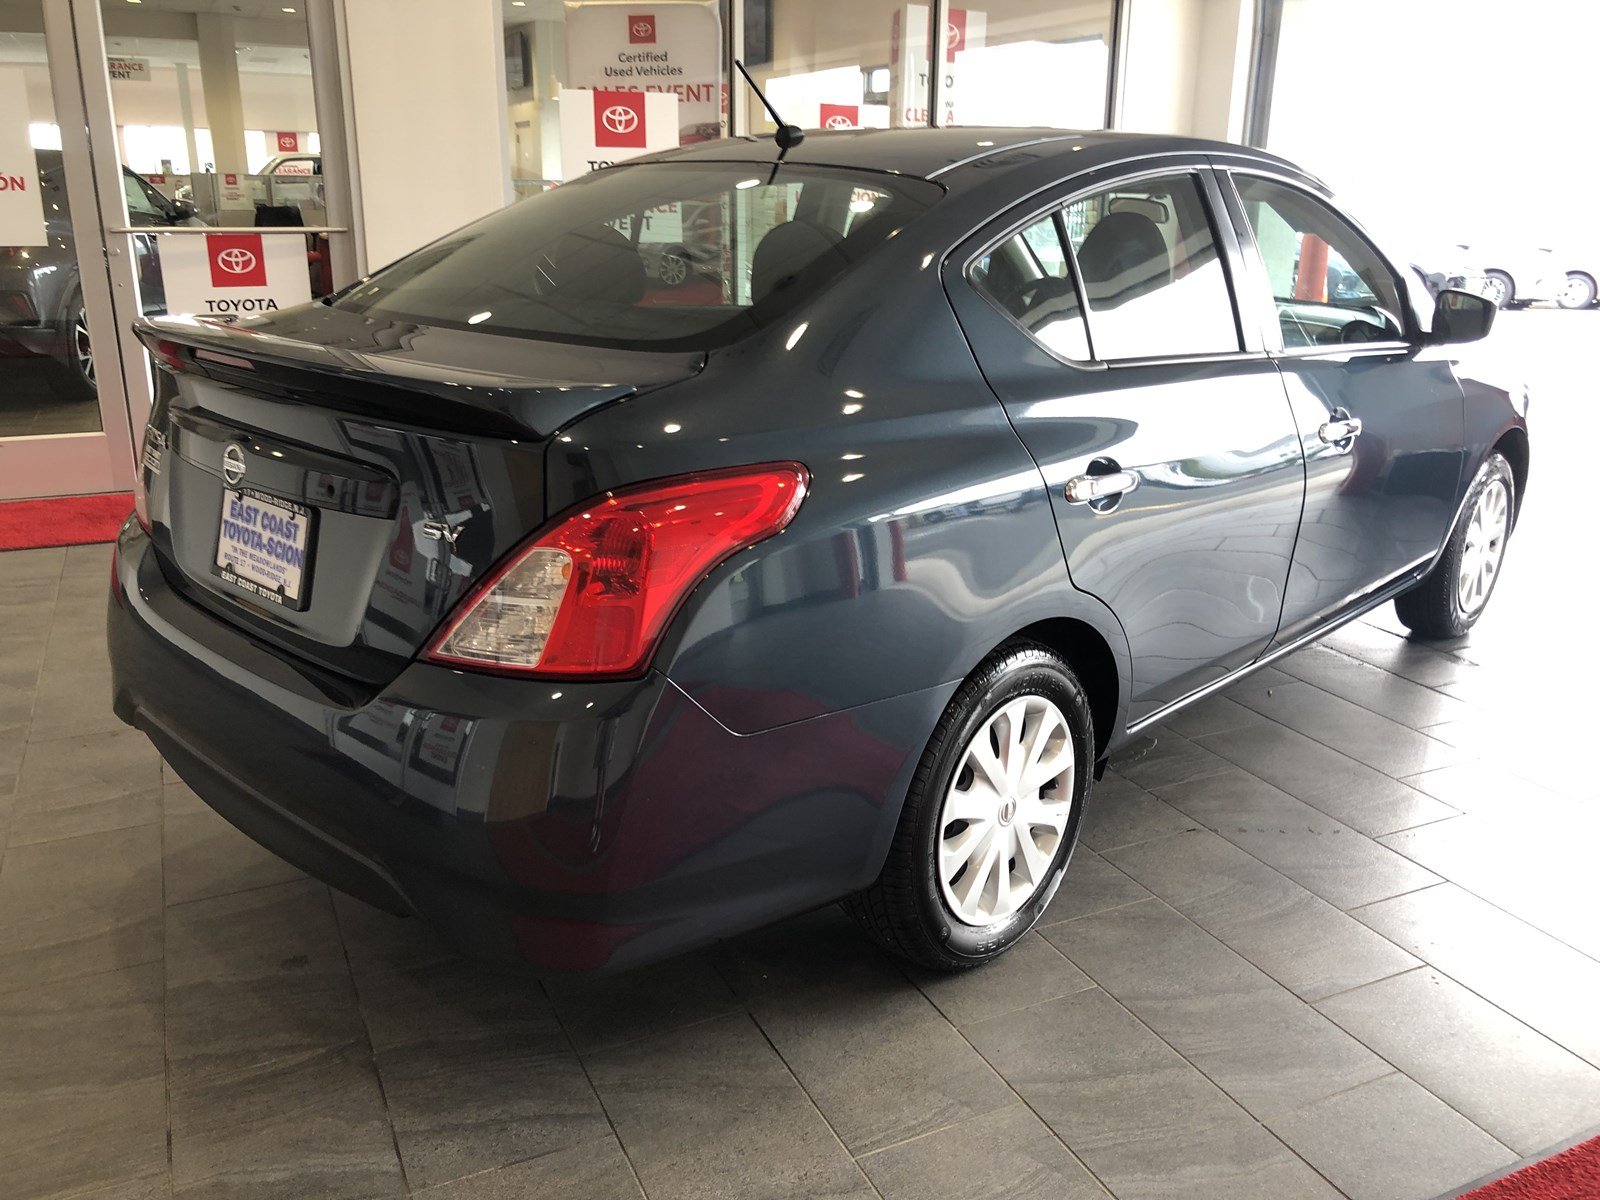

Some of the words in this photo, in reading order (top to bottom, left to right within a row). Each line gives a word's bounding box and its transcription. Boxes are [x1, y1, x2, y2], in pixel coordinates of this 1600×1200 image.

[604, 66, 633, 77] Used
[635, 65, 683, 76] Vehicles
[618, 51, 668, 63] Certified
[205, 298, 279, 313] TOYOTA
[230, 499, 260, 527] EAST
[261, 511, 300, 544] COAST
[423, 521, 466, 553] SV
[223, 519, 305, 568] TOYOTA-SCION
[220, 570, 238, 584] EAST
[237, 577, 258, 593] COAST
[258, 586, 283, 604] TOYOTA
